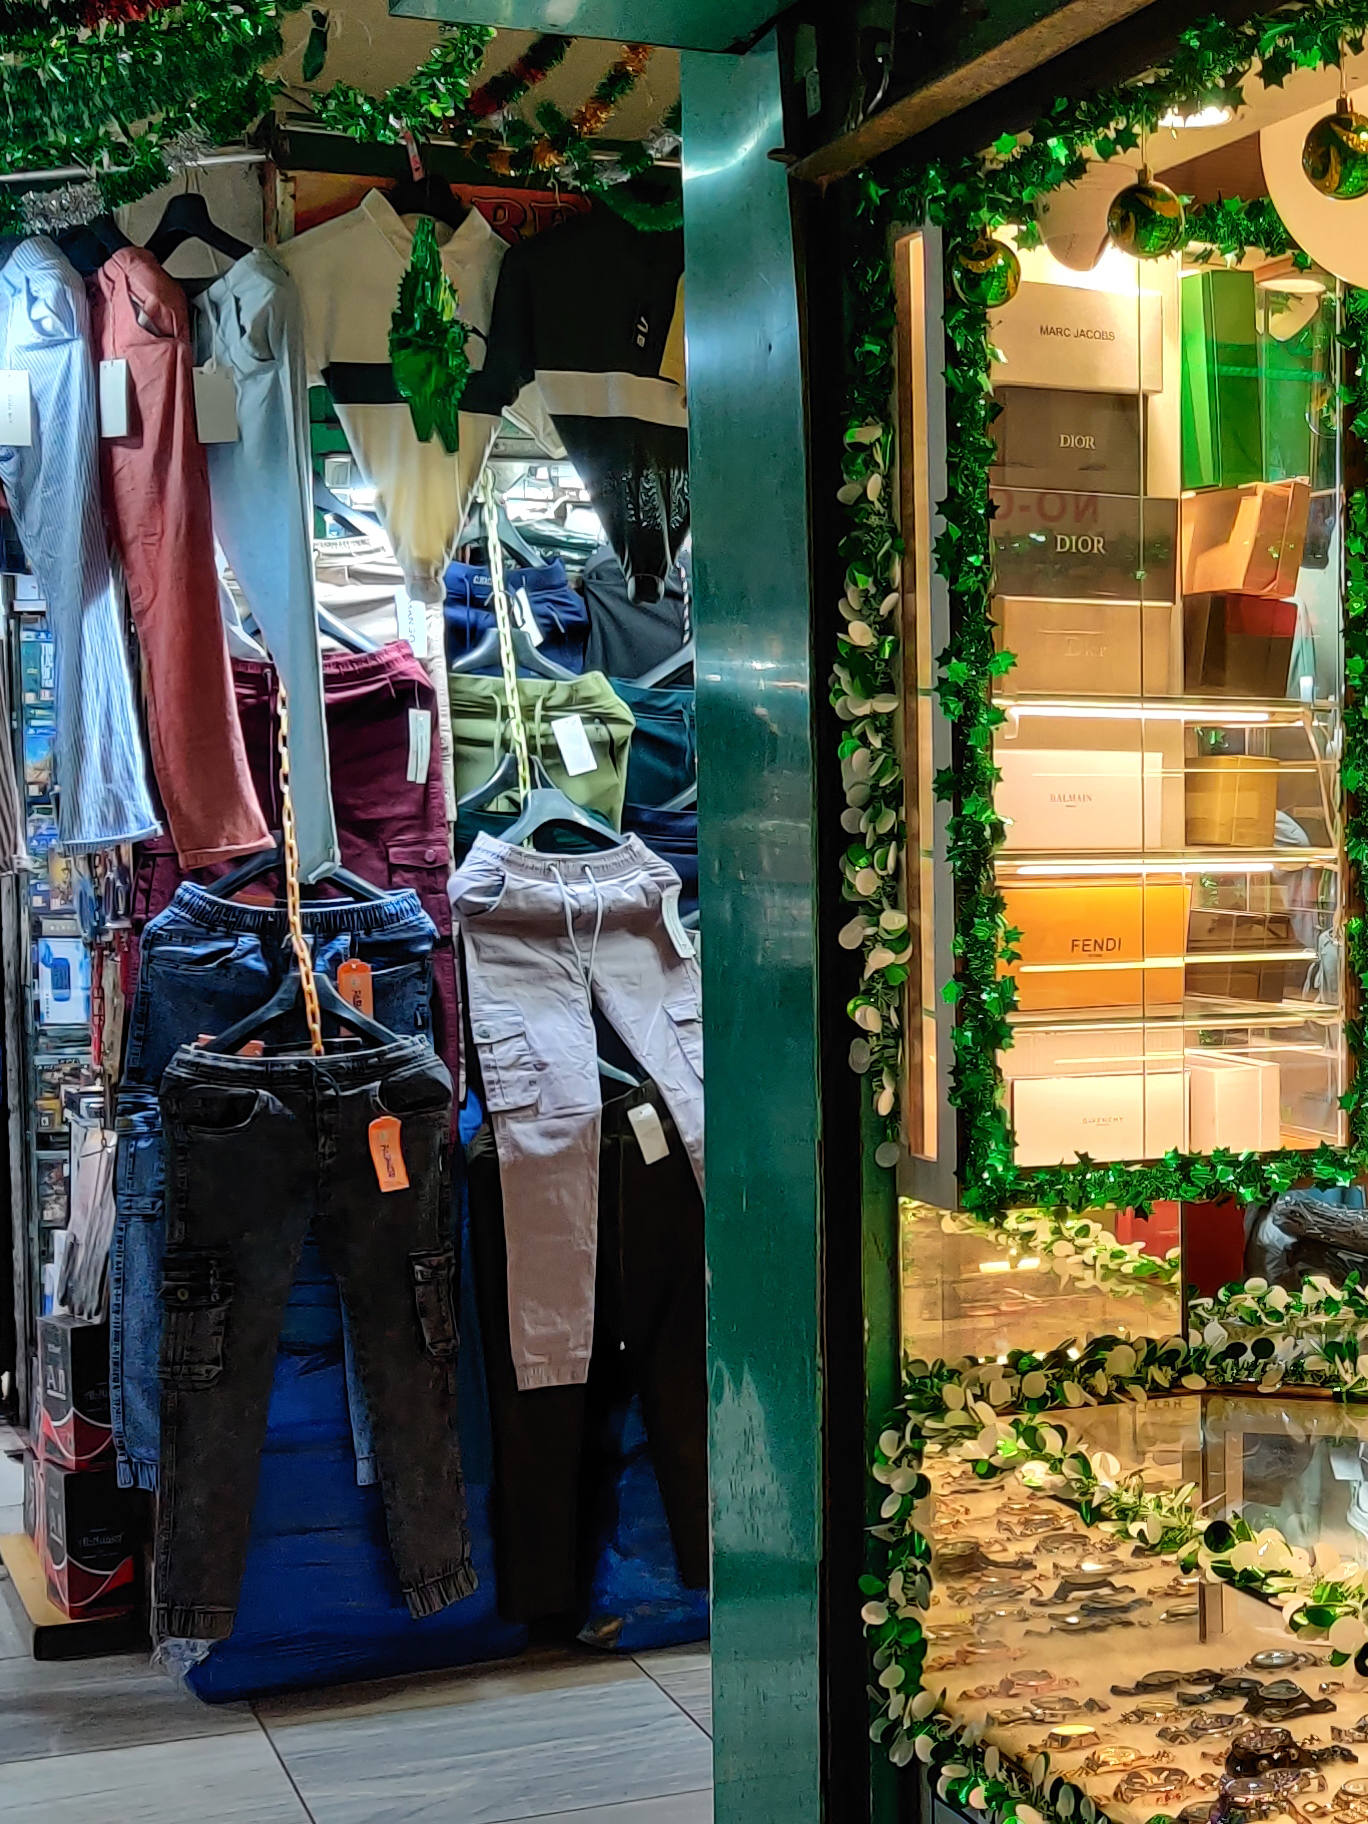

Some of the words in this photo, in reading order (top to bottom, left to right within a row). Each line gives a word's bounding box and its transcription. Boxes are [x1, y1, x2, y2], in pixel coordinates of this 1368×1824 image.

[1040, 324, 1071, 338] MARC
[1074, 327, 1116, 341] JACOBS
[1059, 433, 1096, 450] DIOR
[1055, 533, 1106, 555] DIOR
[1071, 936, 1122, 953] FENDI
